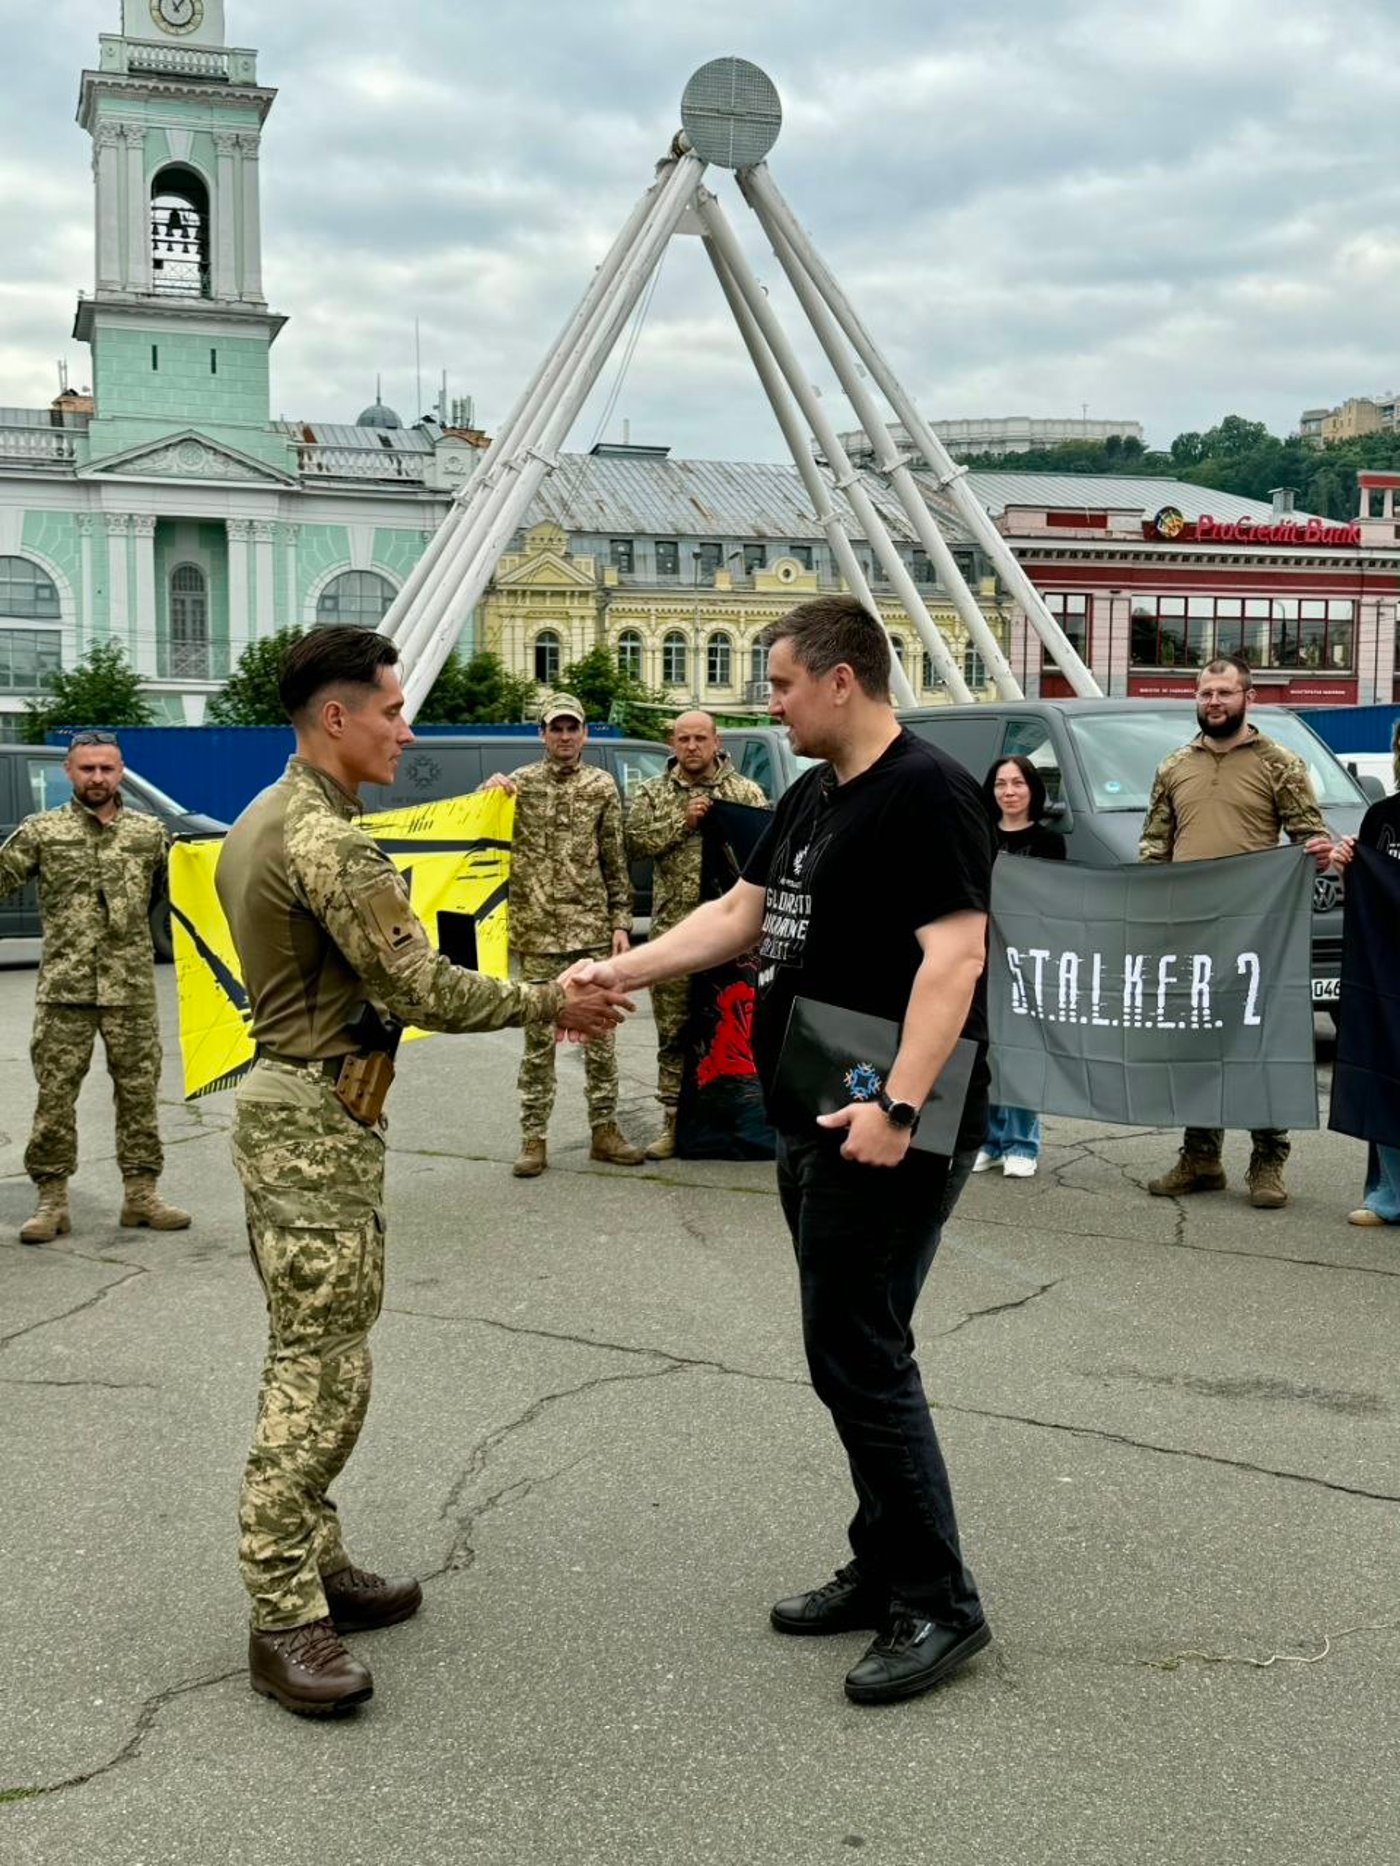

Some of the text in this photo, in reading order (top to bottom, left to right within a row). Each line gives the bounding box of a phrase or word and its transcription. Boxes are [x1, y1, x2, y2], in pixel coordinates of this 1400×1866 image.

[1196, 514, 1361, 543] ProCredit Bank
[1236, 952, 1261, 1026] 2
